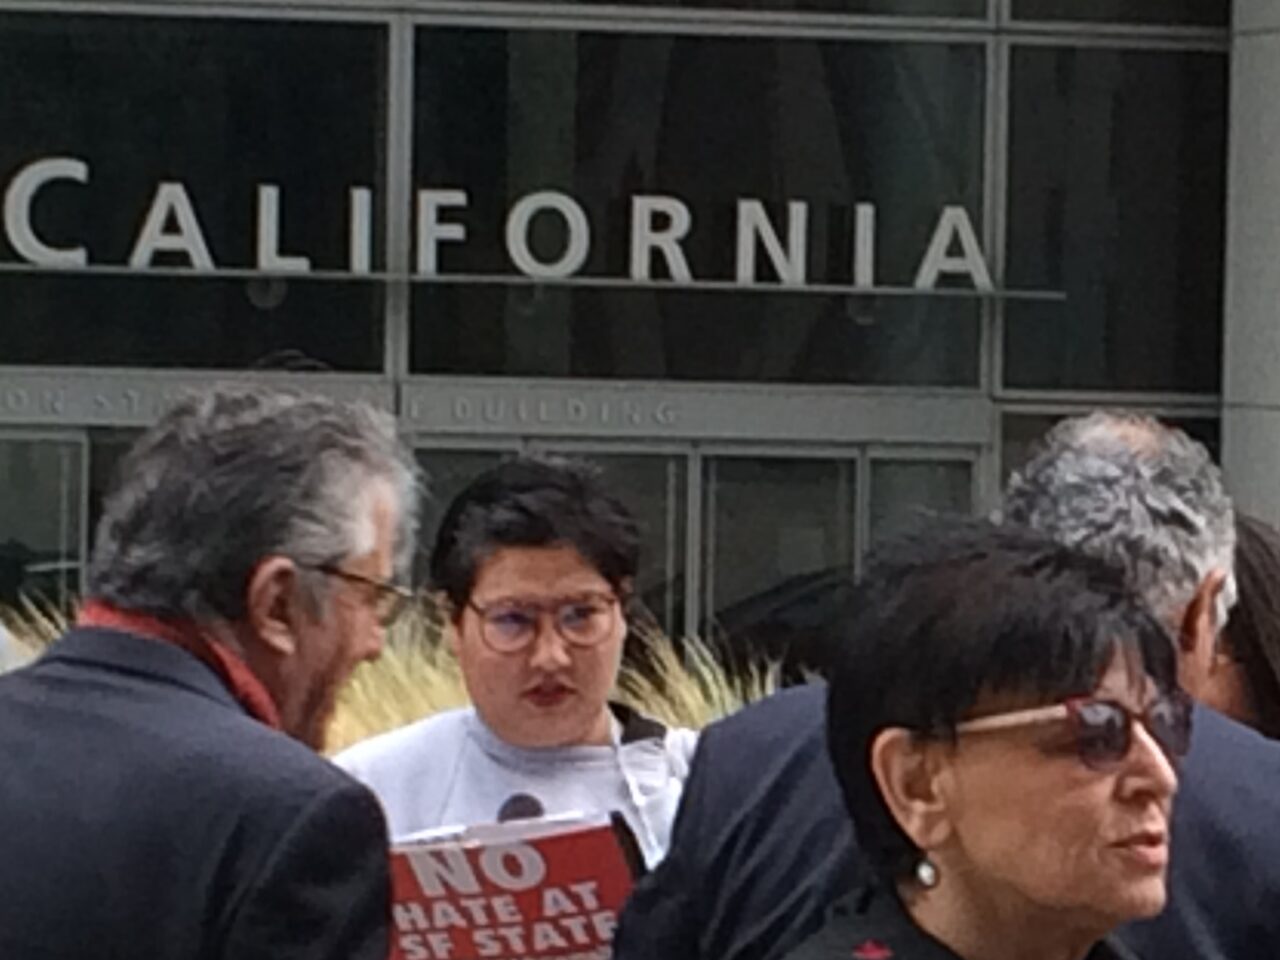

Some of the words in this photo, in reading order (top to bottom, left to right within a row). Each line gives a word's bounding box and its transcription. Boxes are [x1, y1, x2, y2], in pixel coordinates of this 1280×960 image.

[3, 157, 994, 293] CALIFORNIA
[403, 842, 546, 897] NO
[393, 894, 523, 931] HATE
[543, 880, 598, 917] AT
[472, 910, 619, 957] STATE
